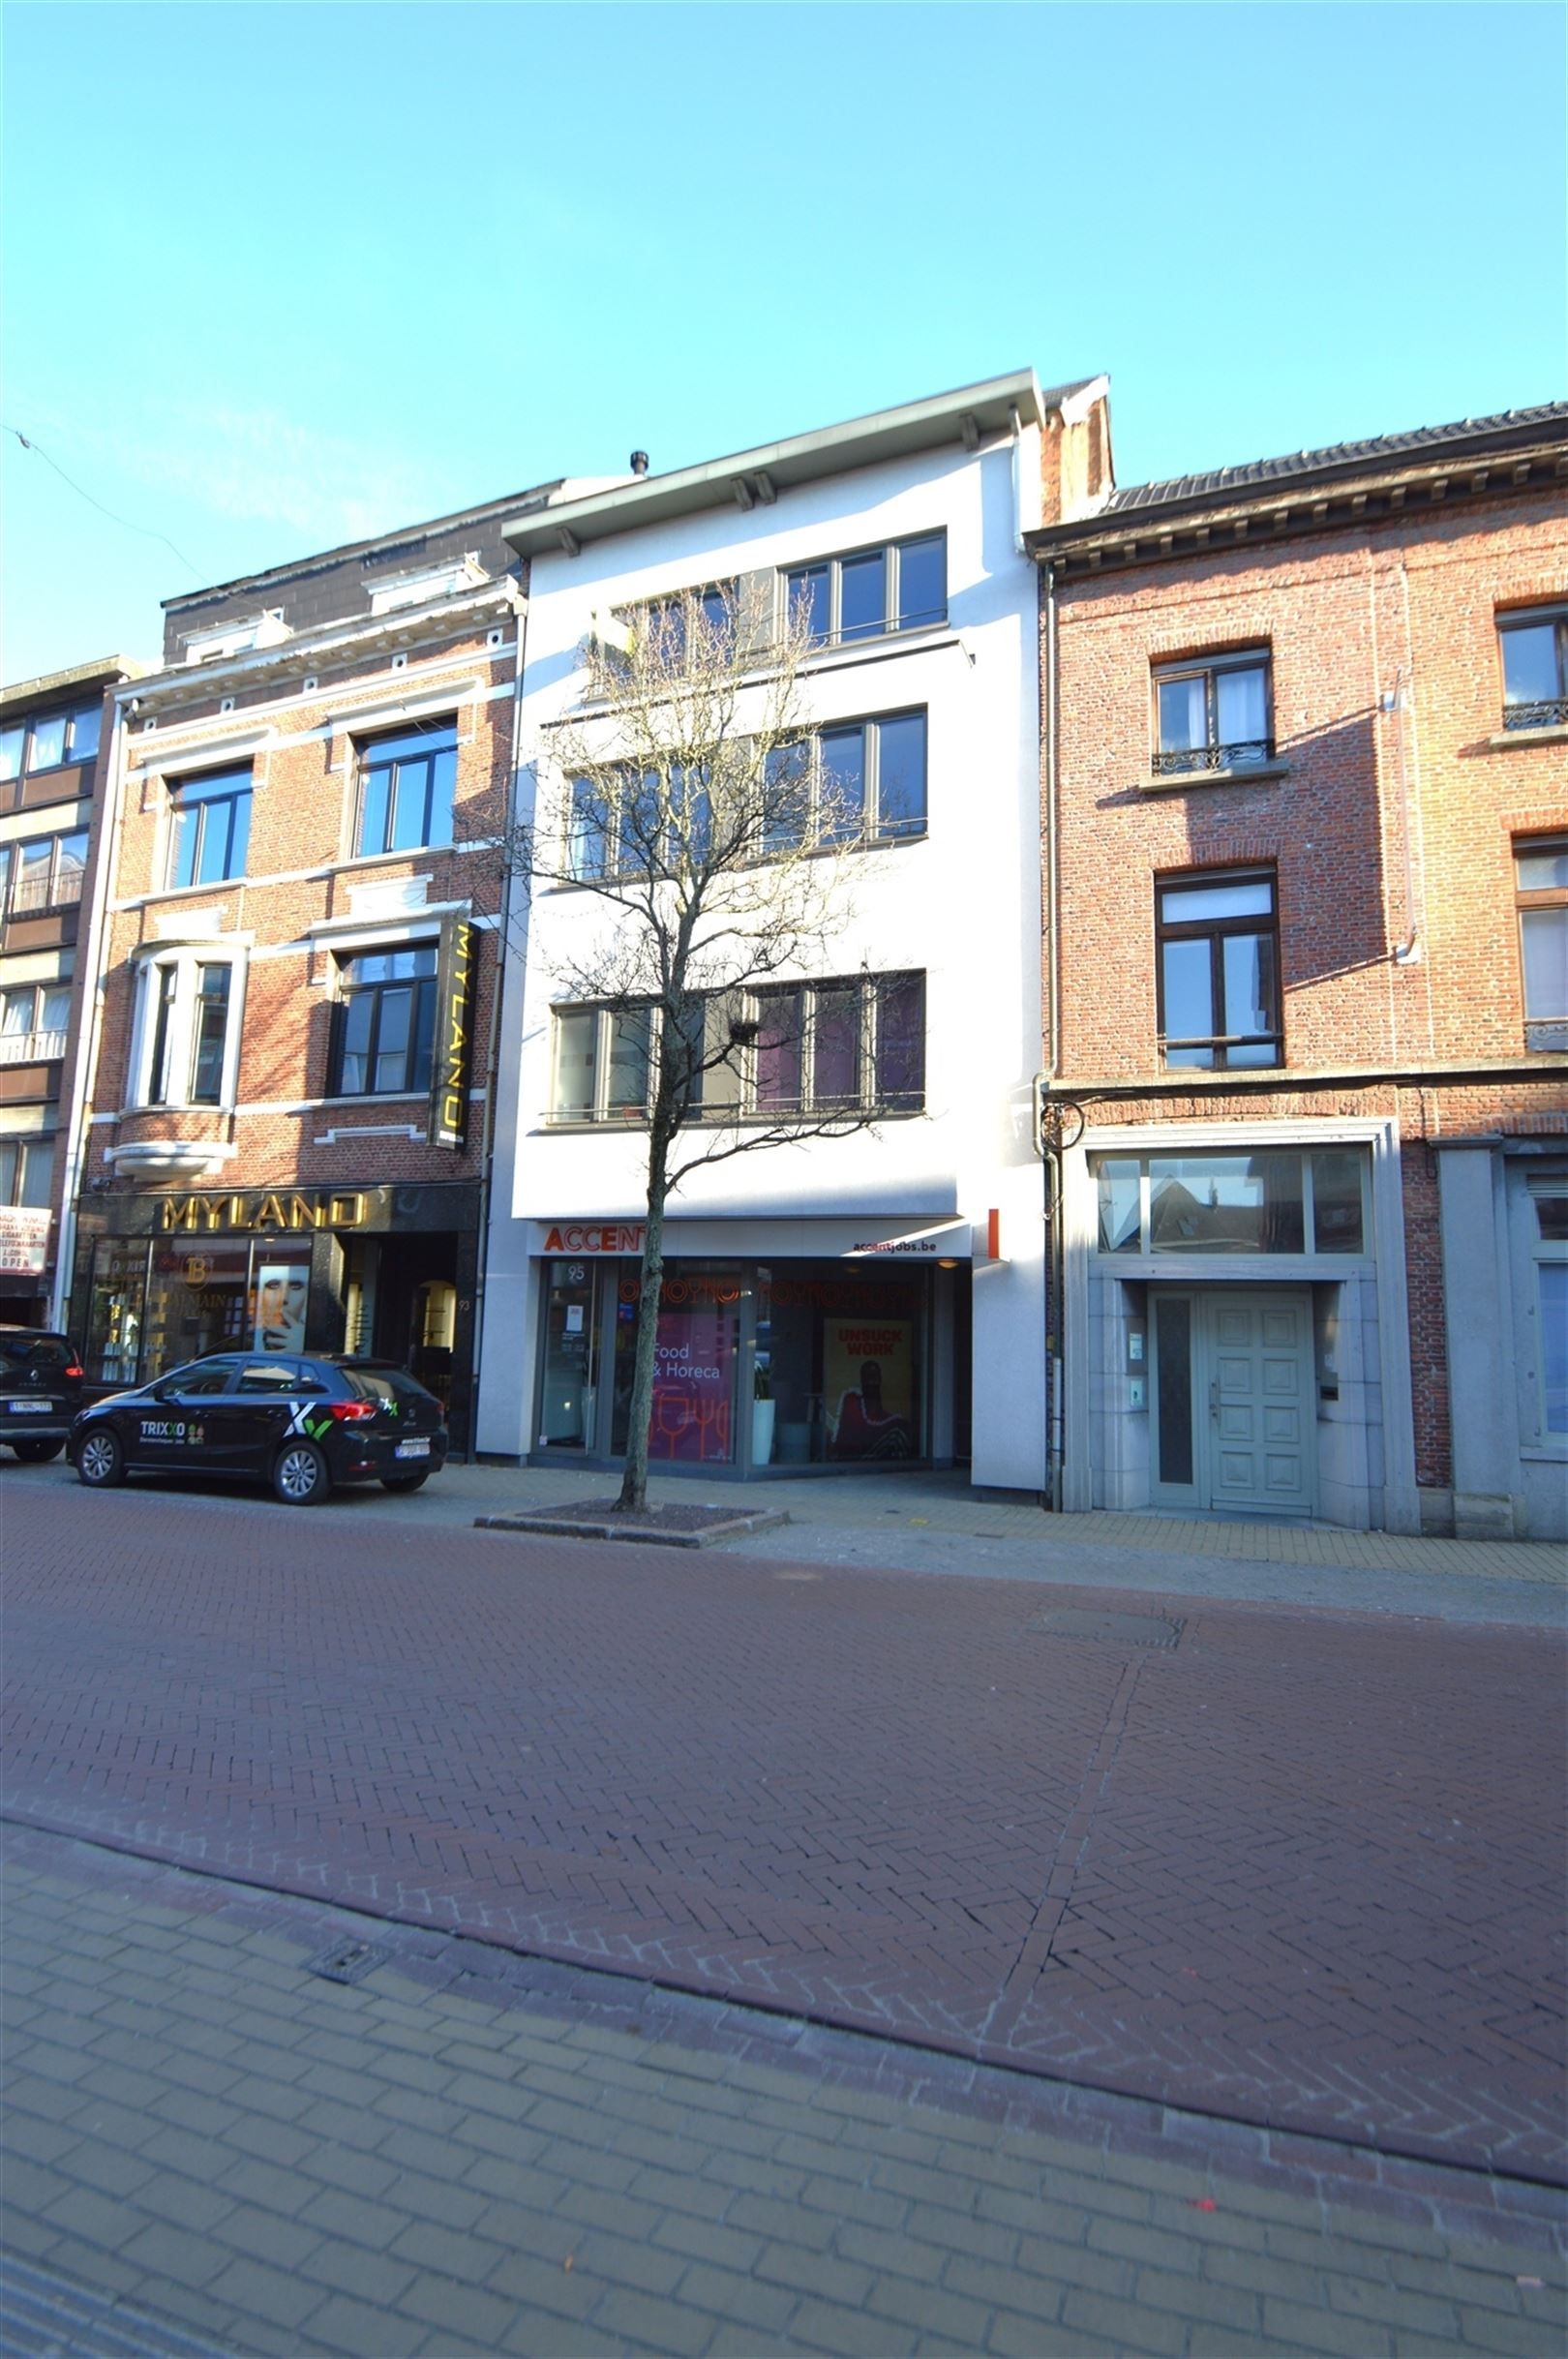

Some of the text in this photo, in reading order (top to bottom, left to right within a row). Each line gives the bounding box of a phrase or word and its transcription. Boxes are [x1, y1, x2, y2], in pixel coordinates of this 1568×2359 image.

[544, 1225, 647, 1252] ACCEN
[854, 1241, 937, 1254] accentjobs.be
[2, 1257, 29, 1267] OPEN
[568, 1265, 585, 1280] 95
[459, 1300, 470, 1311] 93
[838, 1328, 903, 1342] UNSUCK
[847, 1343, 892, 1355] WORK
[666, 1362, 720, 1379] Horeca
[140, 1421, 186, 1437] TRIXXO
